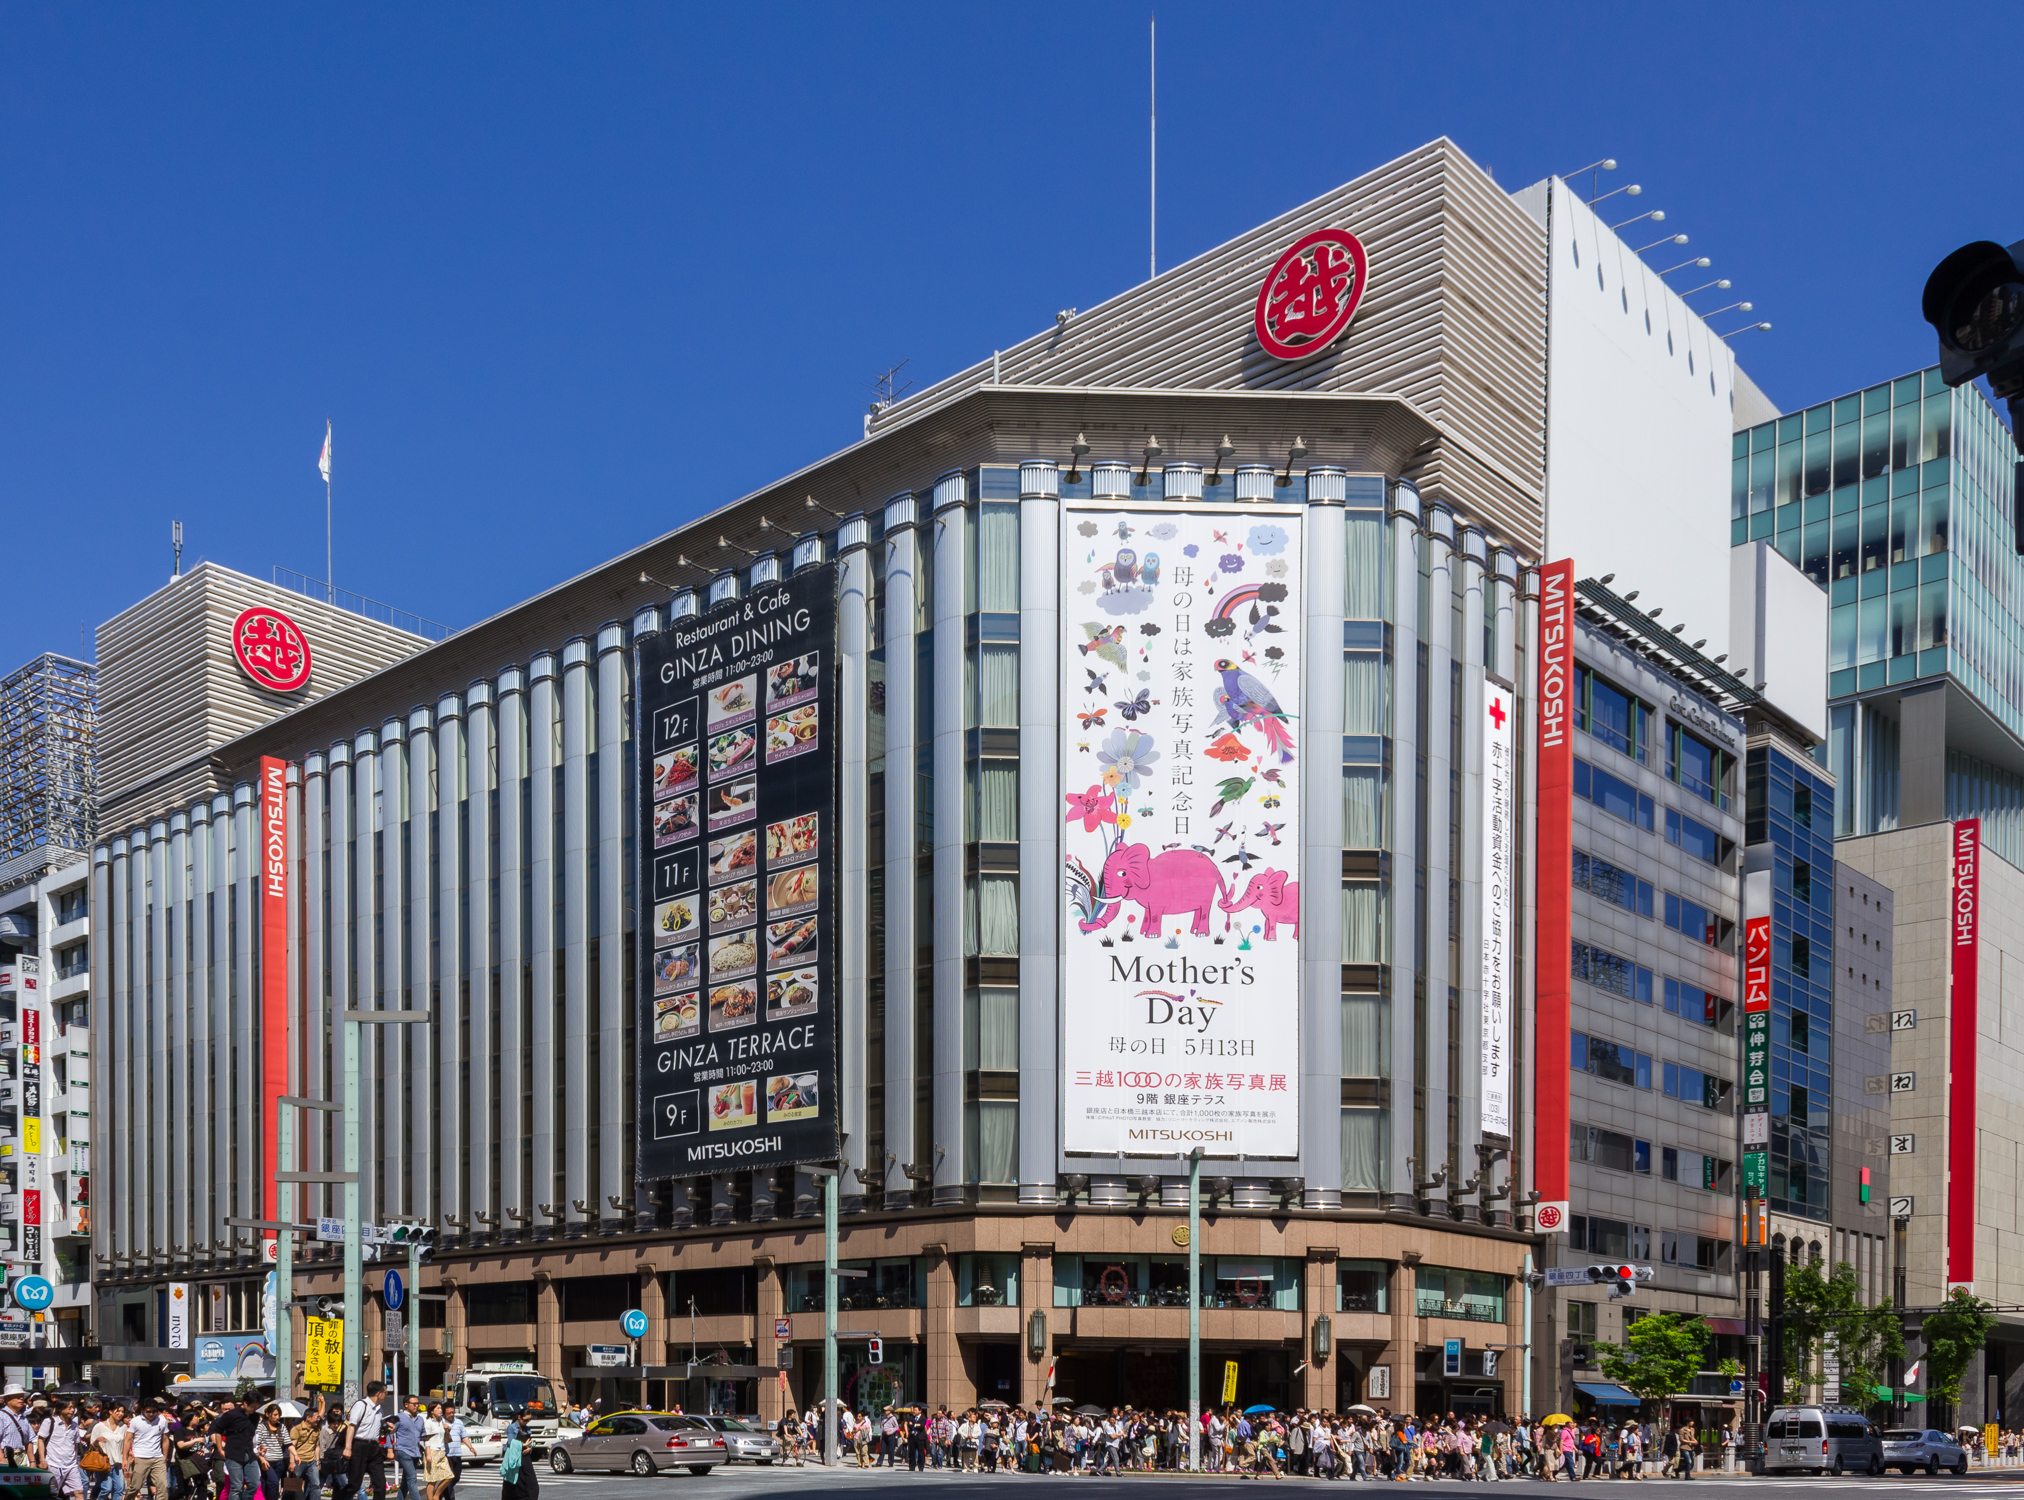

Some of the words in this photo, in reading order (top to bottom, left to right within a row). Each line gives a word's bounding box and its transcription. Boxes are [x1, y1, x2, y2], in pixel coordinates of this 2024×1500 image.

[675, 611, 740, 649] Restaurant
[743, 603, 755, 620] &
[757, 588, 791, 613] Cafe
[660, 643, 724, 685] GINZA
[732, 608, 811, 659] DINING
[1543, 572, 1565, 748] MITSUKOSHI
[692, 668, 723, 690] 営業時間
[1170, 565, 1194, 836] 母の日は家族写真記念日
[662, 713, 689, 740] 12F
[267, 766, 283, 898] MITSUKOSHI
[664, 862, 690, 888] 11F
[1957, 827, 1974, 946] MITSUKOSHI
[1746, 924, 1769, 1004] バンコム
[1145, 997, 1217, 1033] Day
[657, 1042, 719, 1073] GINZA
[728, 1024, 815, 1060] TERRACE
[1108, 1036, 1166, 1055] 母の日
[1184, 1038, 1255, 1057] 5月13日
[1748, 1031, 1765, 1086] 伸芽会
[693, 1067, 724, 1083] 営業時間
[1074, 1070, 1288, 1092] 三越1000の家族写真展
[1136, 1093, 1159, 1105] 9階
[1163, 1093, 1226, 1106] 銀座テラス
[666, 1104, 688, 1127] 9F
[1128, 1128, 1234, 1142] MITSUKOSHI
[687, 1136, 782, 1162] MITSUKOSHI
[321, 1223, 370, 1237] 銀座目
